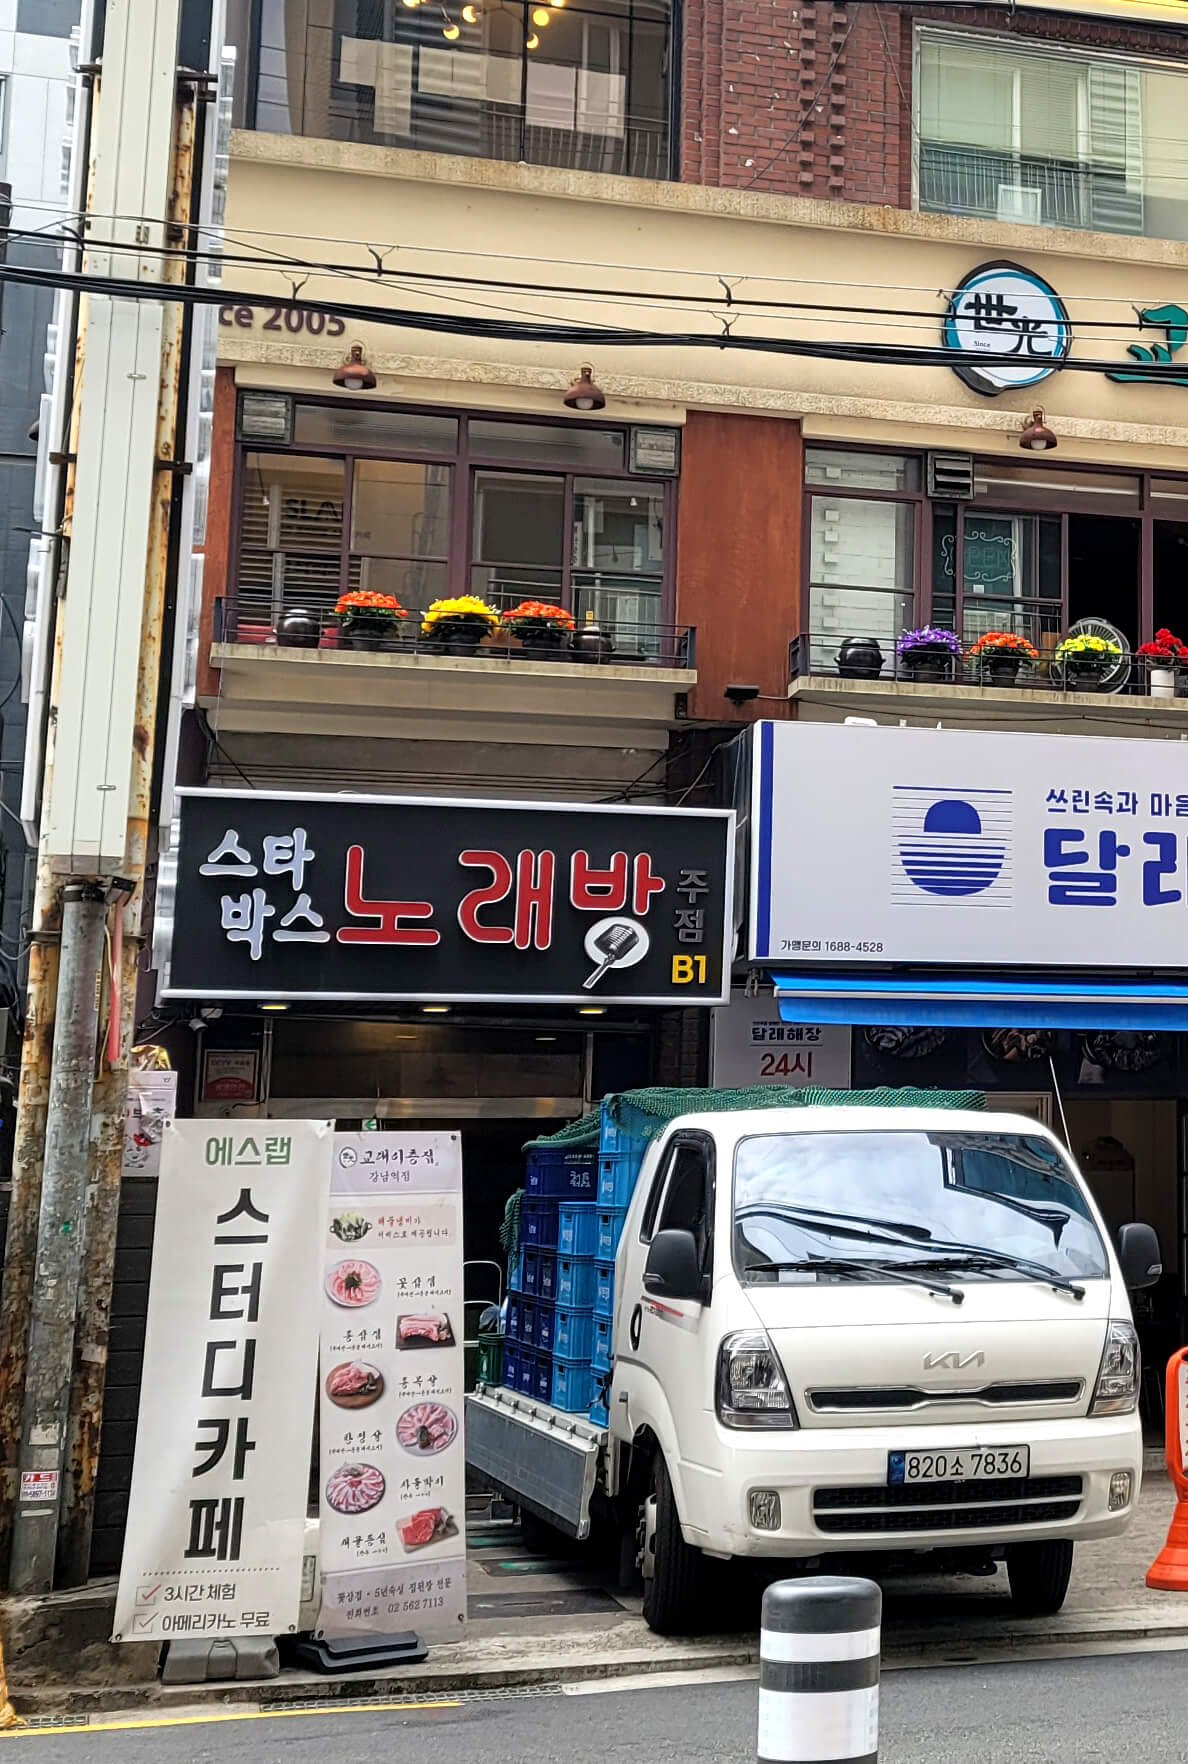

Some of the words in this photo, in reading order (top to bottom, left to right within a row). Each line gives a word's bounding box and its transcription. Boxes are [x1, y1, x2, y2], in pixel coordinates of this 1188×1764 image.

[262, 307, 346, 337] 2005
[1045, 786, 1139, 817] 쓰린속과
[199, 827, 316, 890] 스타
[336, 844, 667, 950] 노래방
[672, 868, 710, 944] 주점
[219, 887, 331, 961] 박스
[780, 940, 822, 952] 가맹문의
[825, 941, 884, 953] 1688-4528
[671, 954, 708, 984] B1
[751, 1026, 823, 1042] 달래해장
[760, 1051, 813, 1079] 24시
[206, 1136, 292, 1166] 에스랩
[359, 1148, 435, 1166] 교대이층집
[184, 1188, 270, 1562] 스터디카페
[164, 1585, 205, 1602] 3시간
[207, 1583, 236, 1601] 체험
[387, 1603, 400, 1613] 02
[402, 1600, 421, 1612] 562
[422, 1596, 444, 1609] 7113
[161, 1614, 237, 1632] 아메리카노
[241, 1611, 271, 1628] 무료
